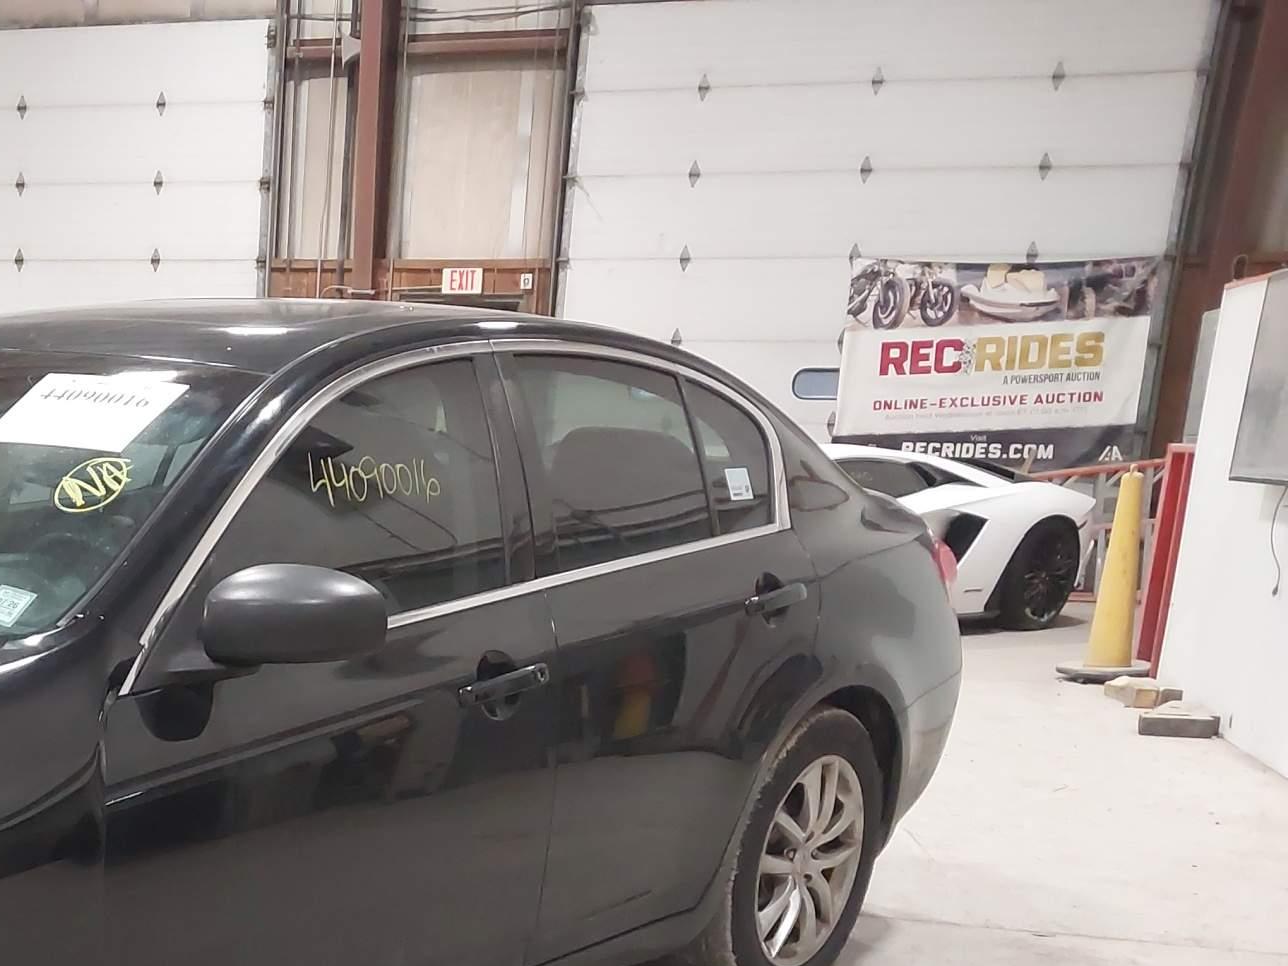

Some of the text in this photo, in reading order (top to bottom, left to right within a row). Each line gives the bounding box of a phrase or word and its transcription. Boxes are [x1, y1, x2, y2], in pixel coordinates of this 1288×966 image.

[449, 270, 477, 291] EXIT
[879, 331, 1106, 377] REC RIDES
[1002, 371, 1101, 385] A POWERSPORT AUCTION
[872, 391, 1104, 412] ONLINE-EXCLUSIVE AUCTION
[970, 434, 988, 442] Visit
[307, 451, 441, 508] 44090016
